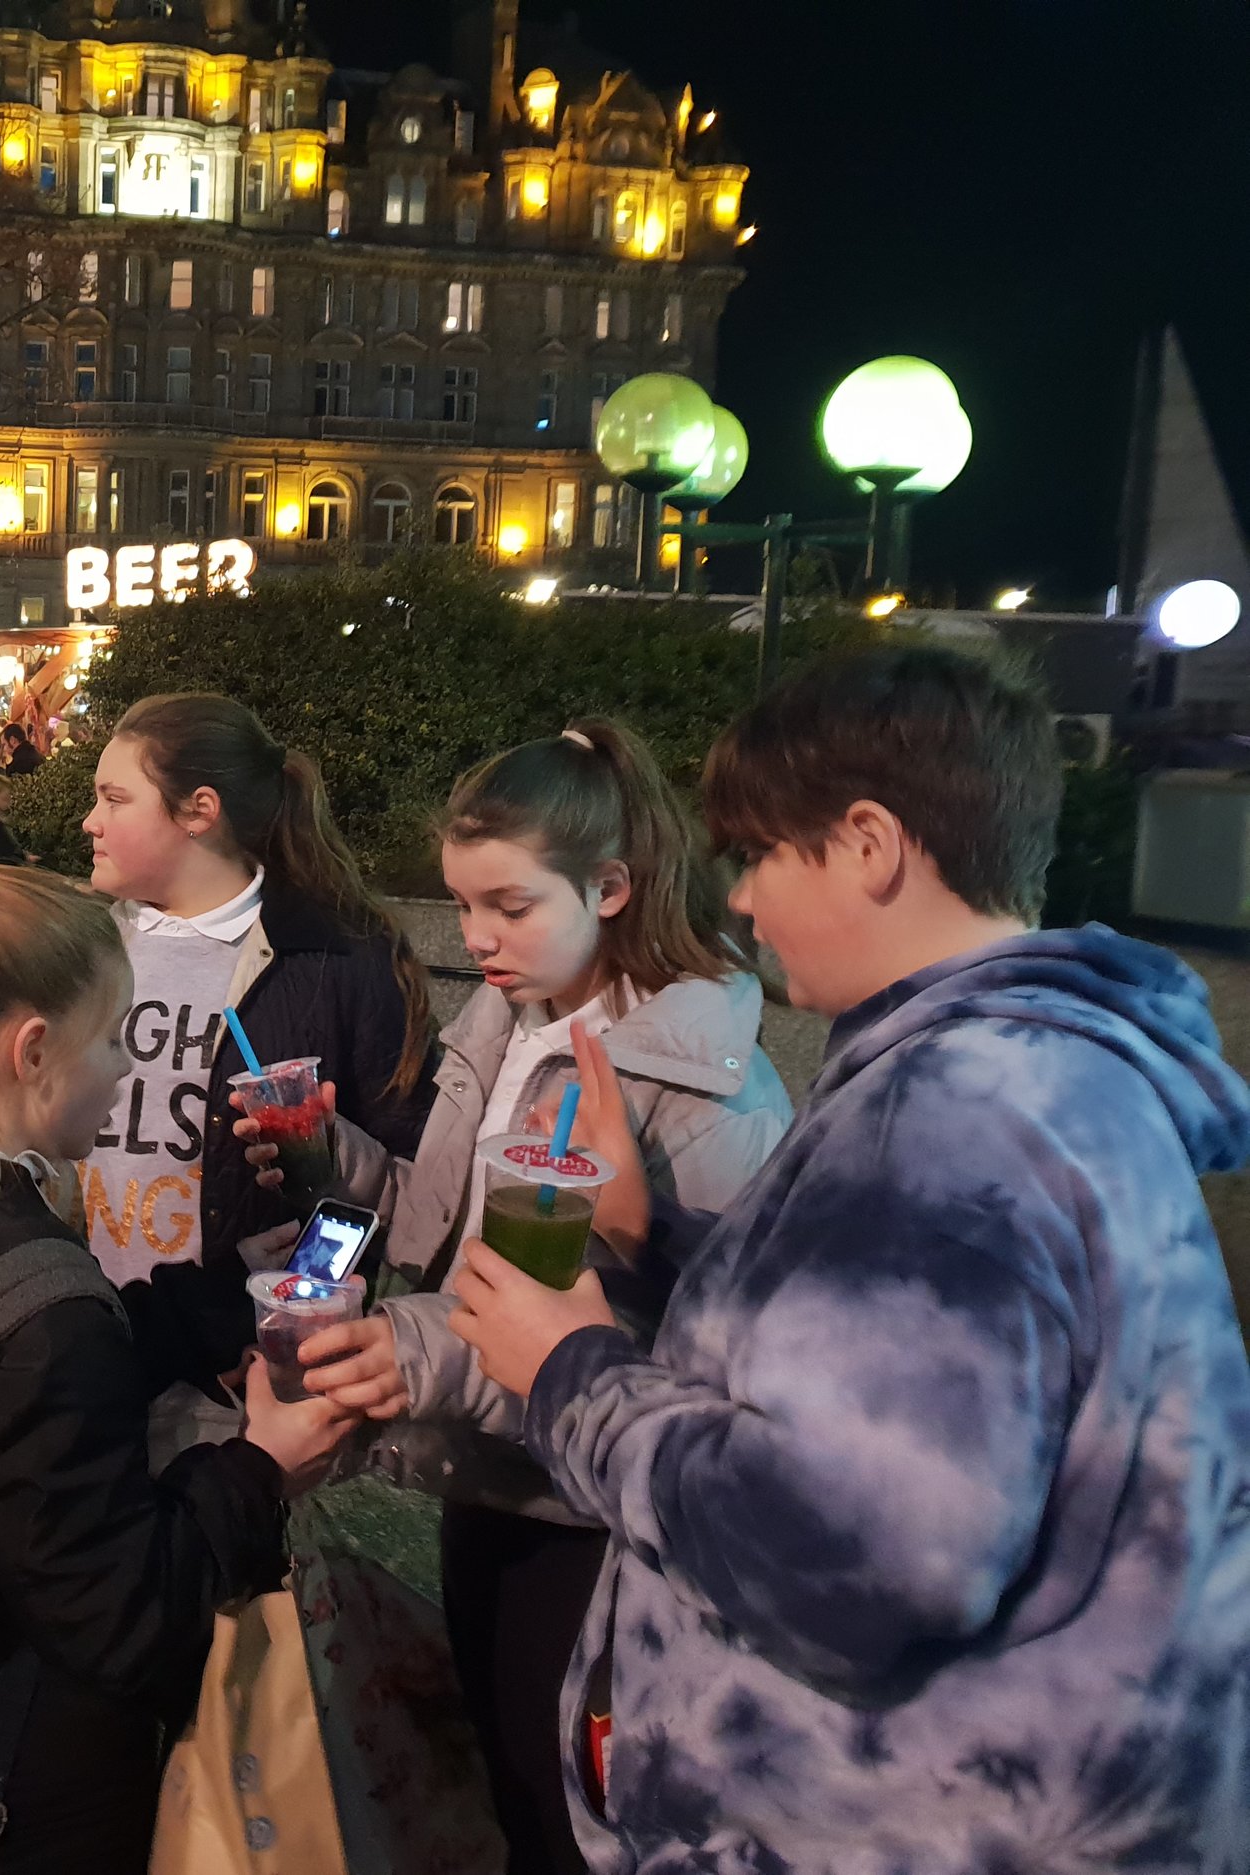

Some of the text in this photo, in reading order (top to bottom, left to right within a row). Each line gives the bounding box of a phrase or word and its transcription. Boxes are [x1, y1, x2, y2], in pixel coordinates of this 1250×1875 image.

[67, 539, 254, 609] BEER
[125, 1000, 221, 1070] GH
[94, 1078, 209, 1161] LS
[77, 1159, 195, 1255] NG
